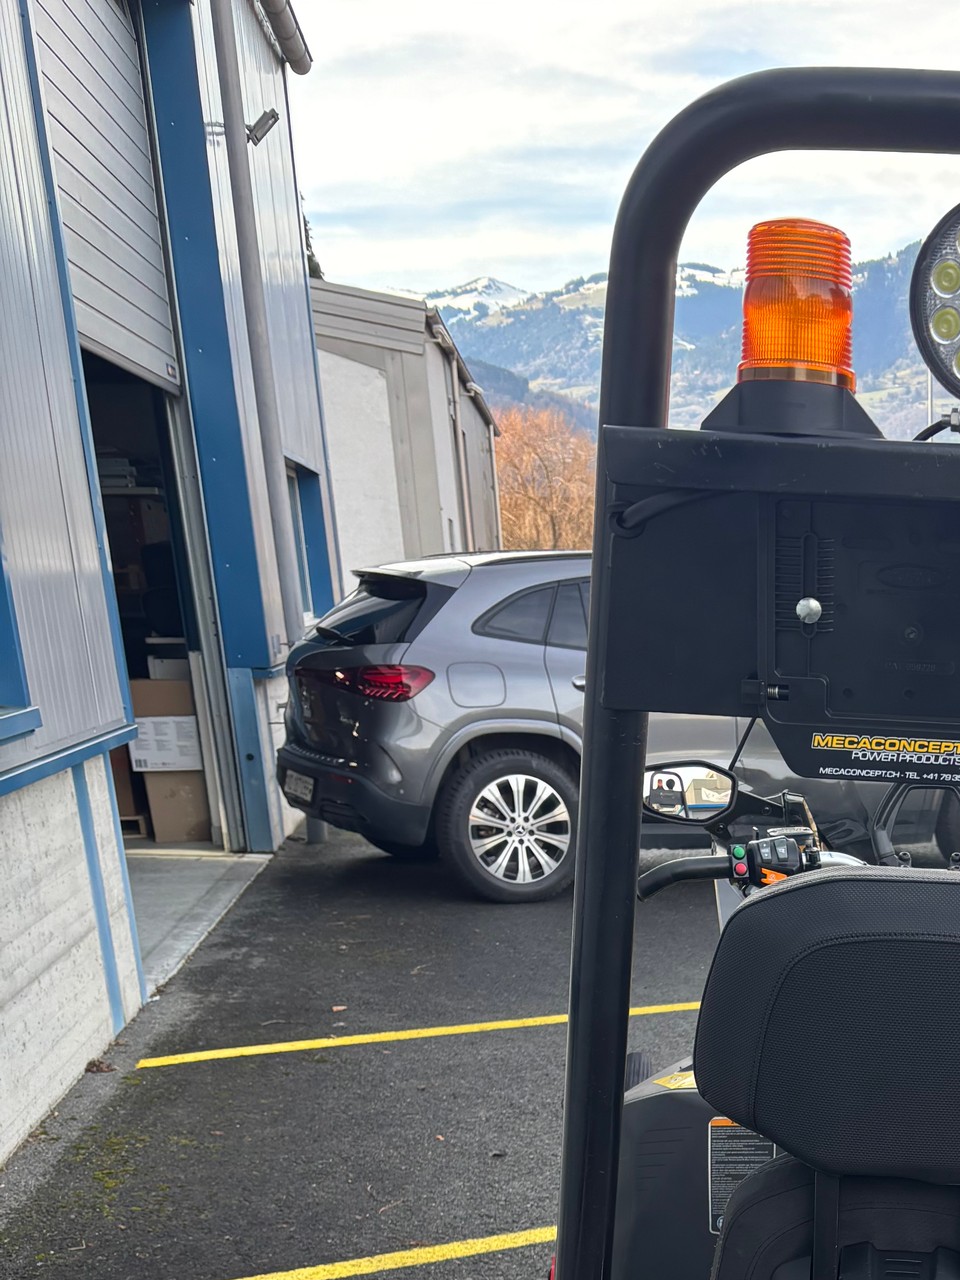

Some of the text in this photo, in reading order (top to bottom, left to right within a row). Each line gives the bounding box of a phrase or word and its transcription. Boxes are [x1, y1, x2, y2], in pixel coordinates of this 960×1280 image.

[851, 750, 897, 762] POWER
[819, 767, 900, 778] MECACONCEPT.CH
[940, 773, 952, 781] 79
